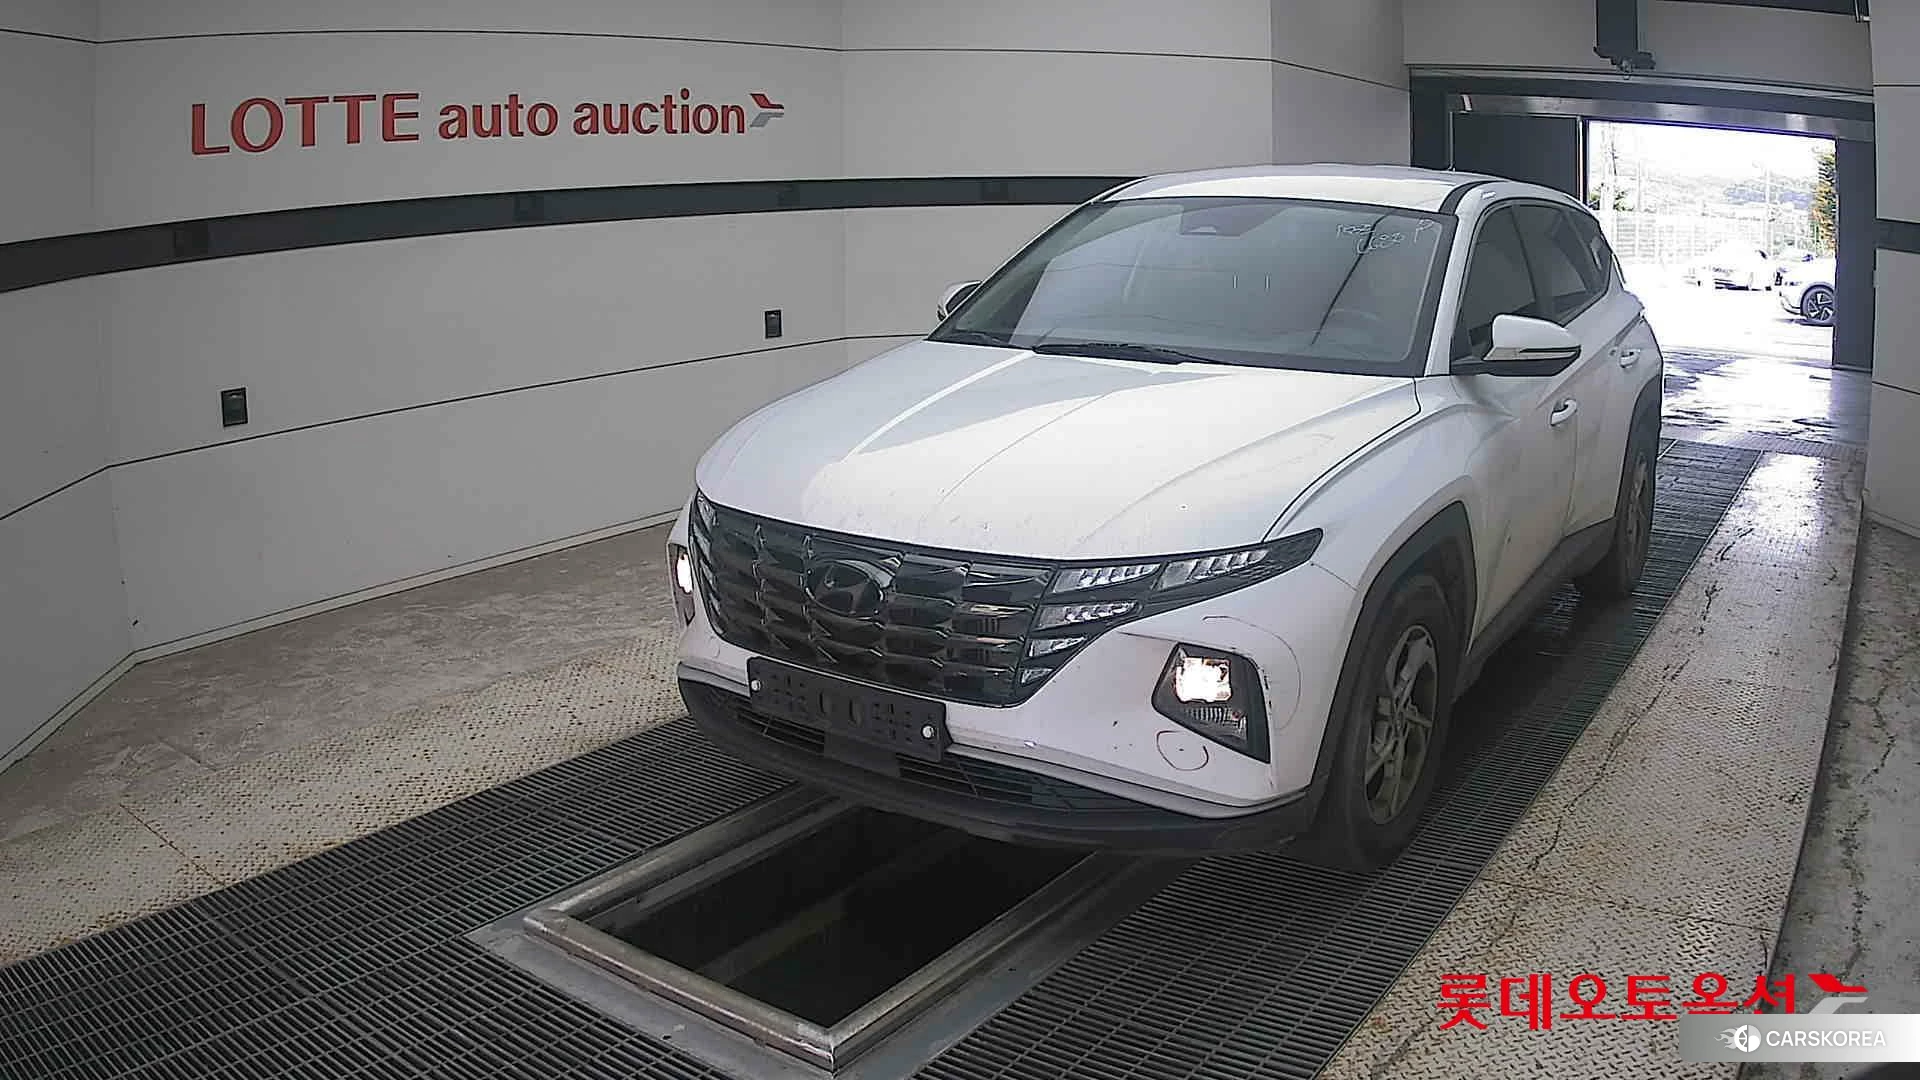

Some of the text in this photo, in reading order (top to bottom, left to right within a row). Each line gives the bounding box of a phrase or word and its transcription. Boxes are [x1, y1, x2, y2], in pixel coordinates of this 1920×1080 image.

[191, 89, 747, 156] LOTTE auto auction
